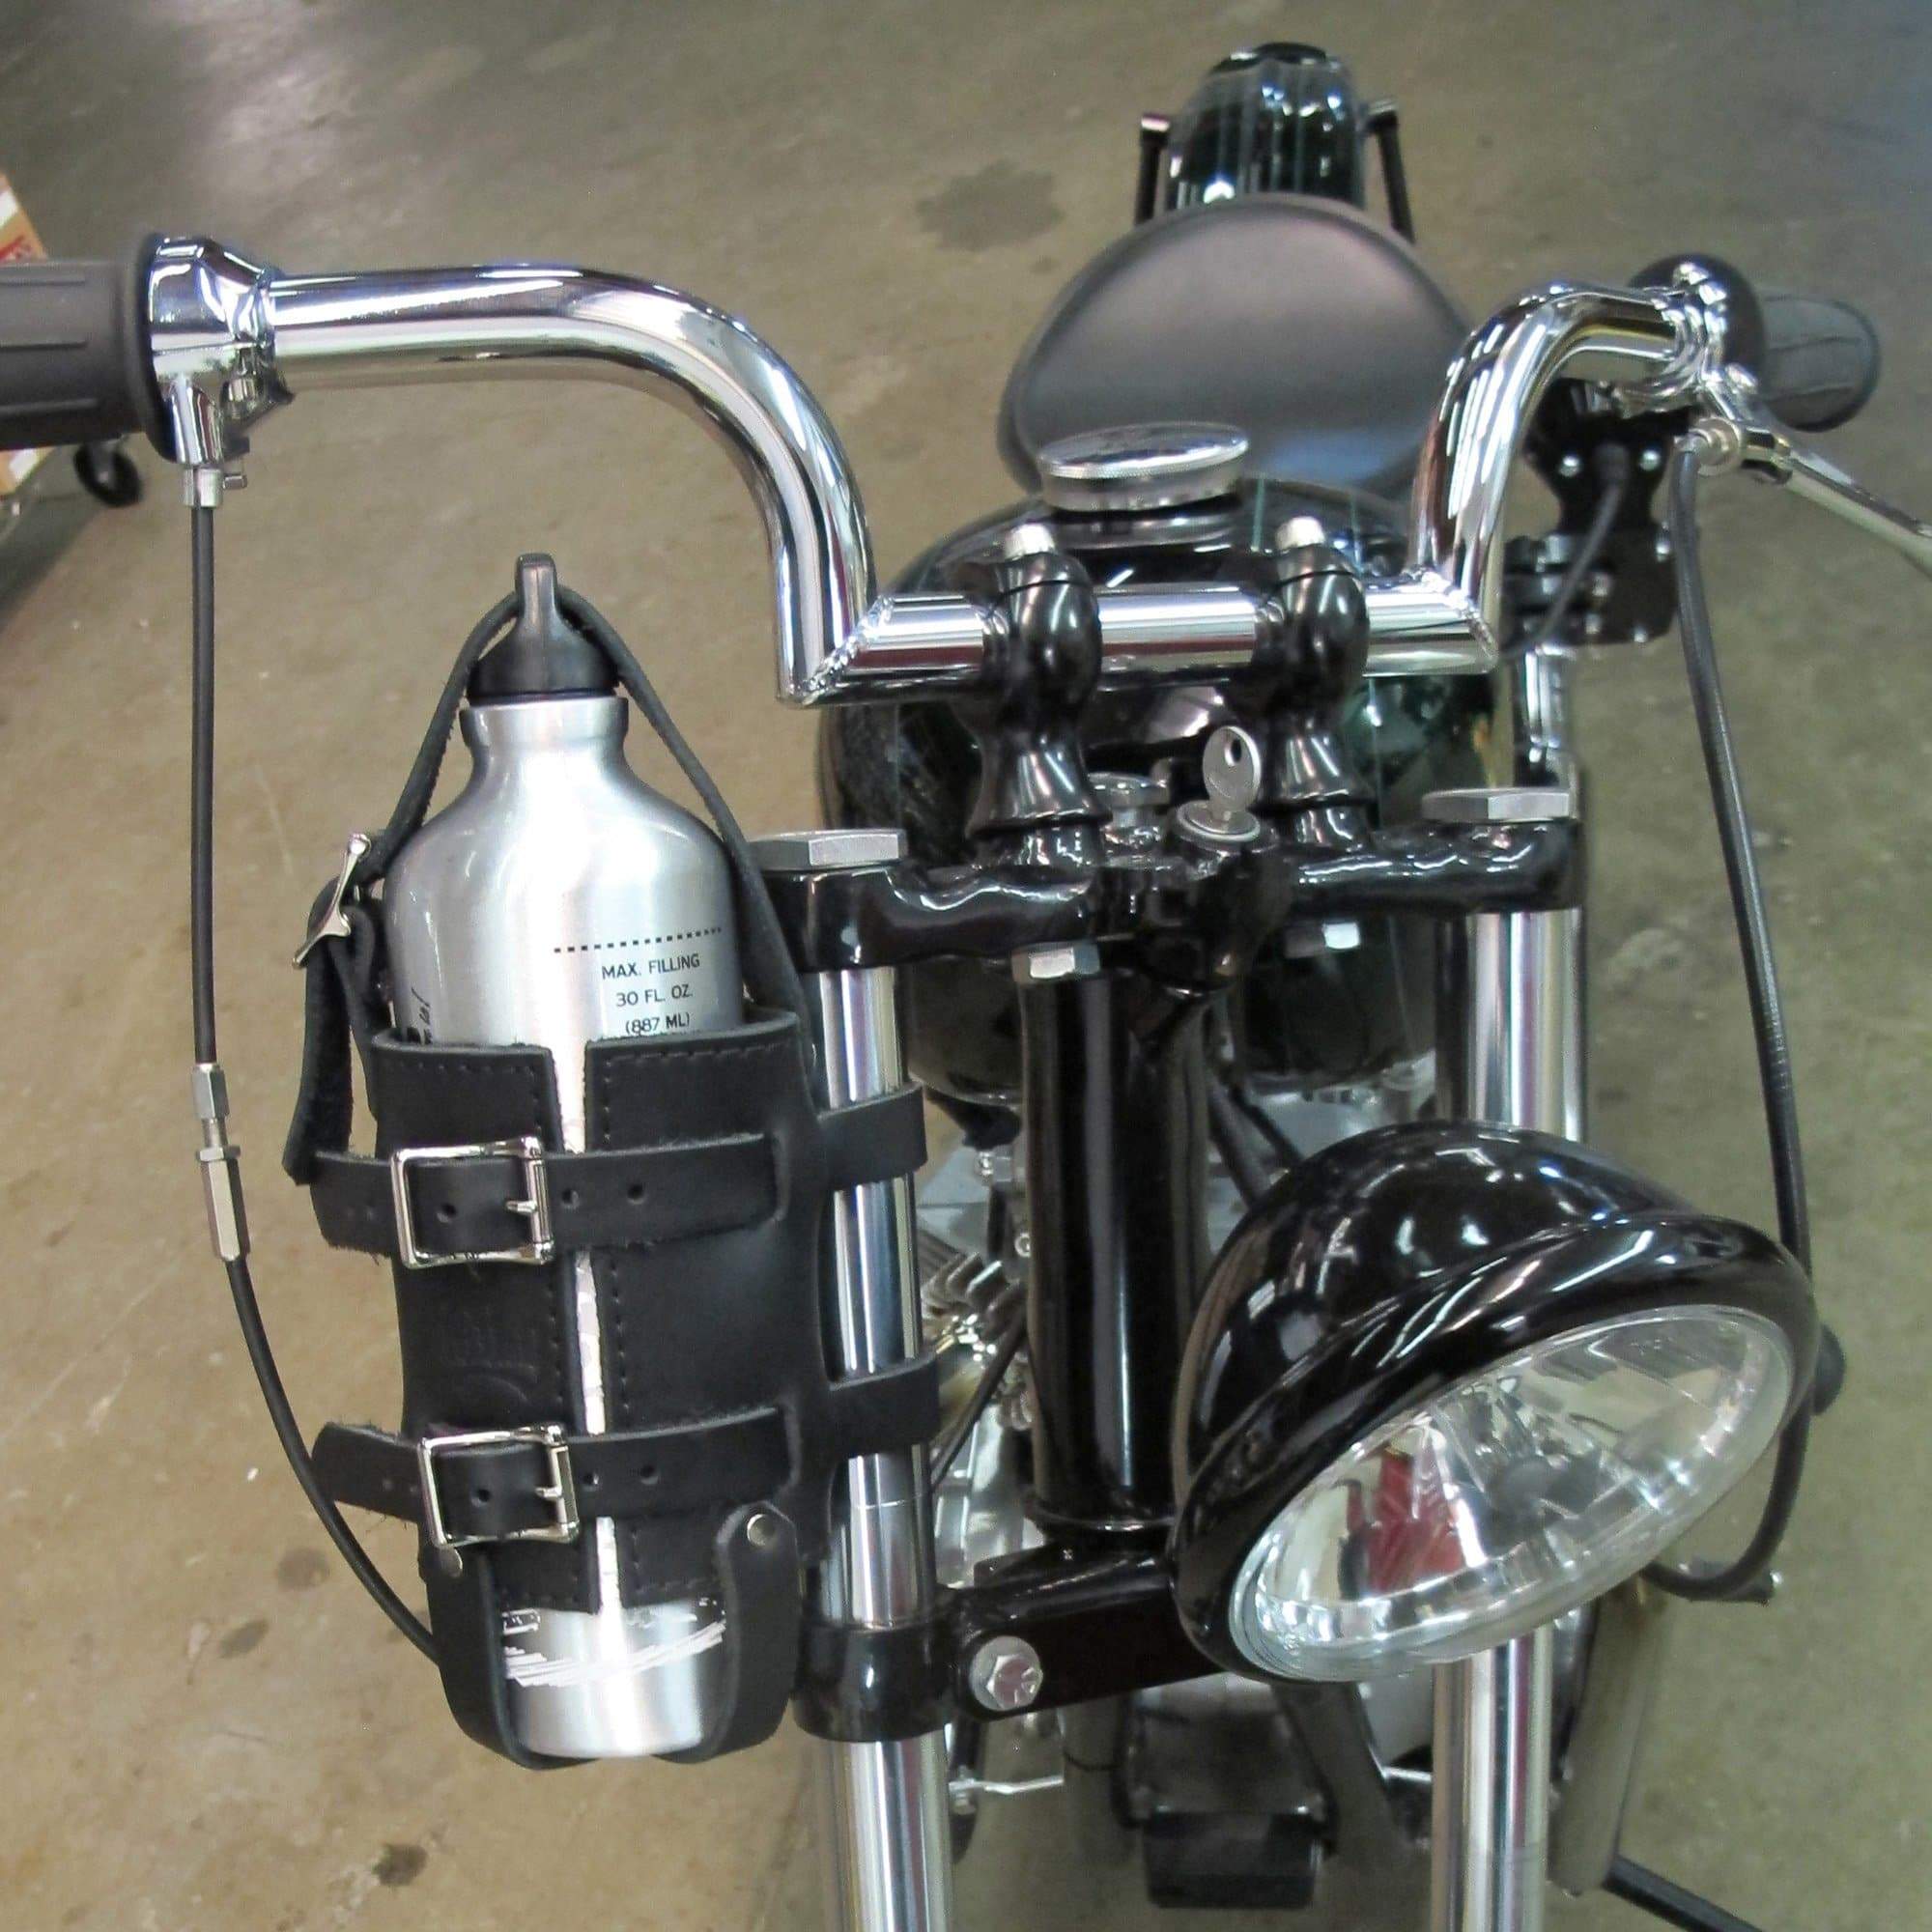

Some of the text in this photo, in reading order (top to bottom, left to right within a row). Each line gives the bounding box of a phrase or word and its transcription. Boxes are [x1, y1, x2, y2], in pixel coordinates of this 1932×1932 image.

[602, 953, 700, 980] MAX. FILLING
[615, 991, 639, 1007] 30
[625, 1011, 690, 1035] (887 ML)
